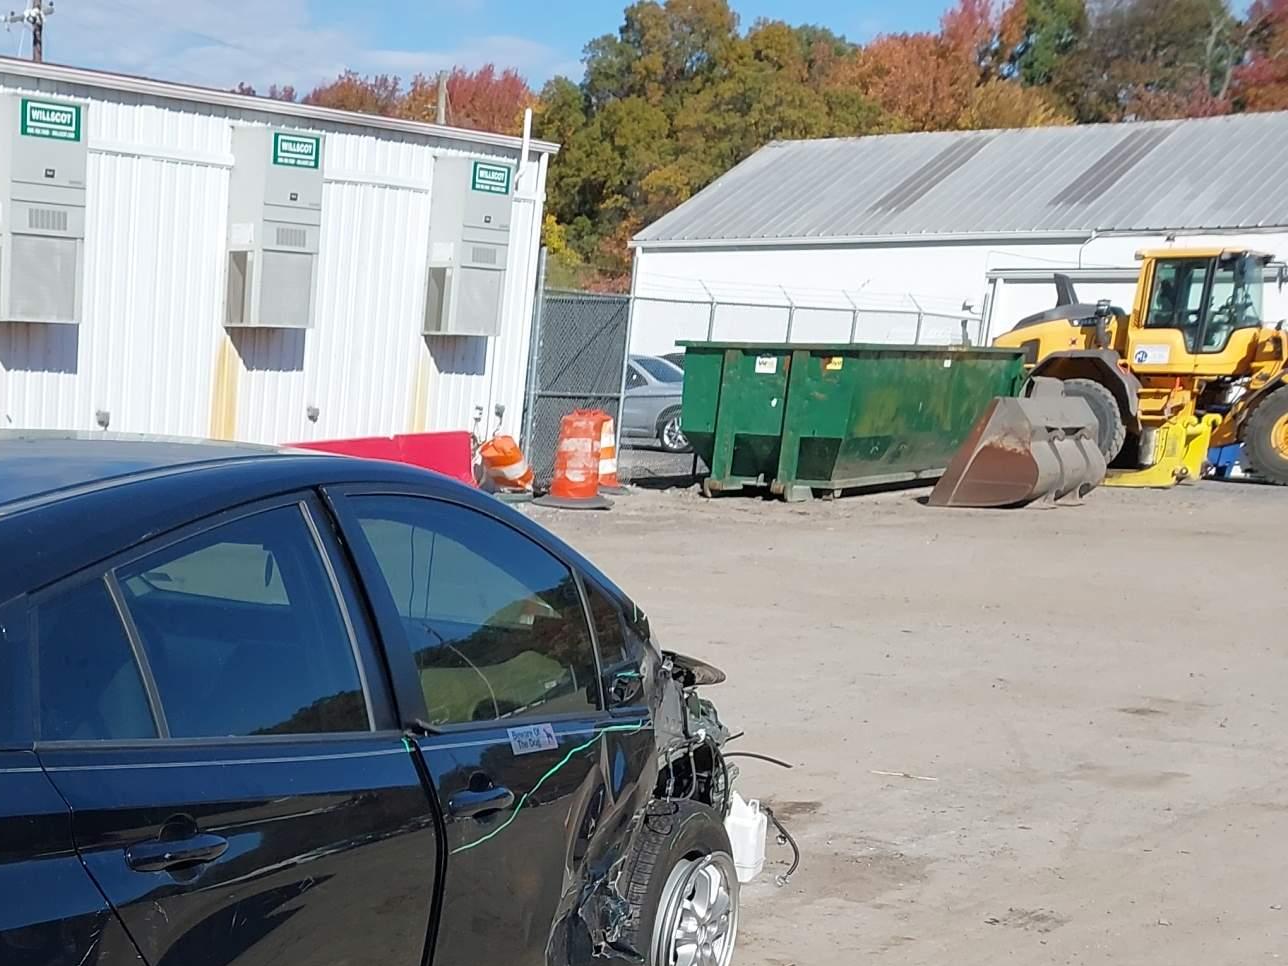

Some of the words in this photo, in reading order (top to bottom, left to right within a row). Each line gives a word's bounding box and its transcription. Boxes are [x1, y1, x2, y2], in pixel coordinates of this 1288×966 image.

[31, 108, 72, 125] WILLSCOT
[281, 141, 313, 154] WILLSCOT
[479, 169, 505, 182] WILLSCOT
